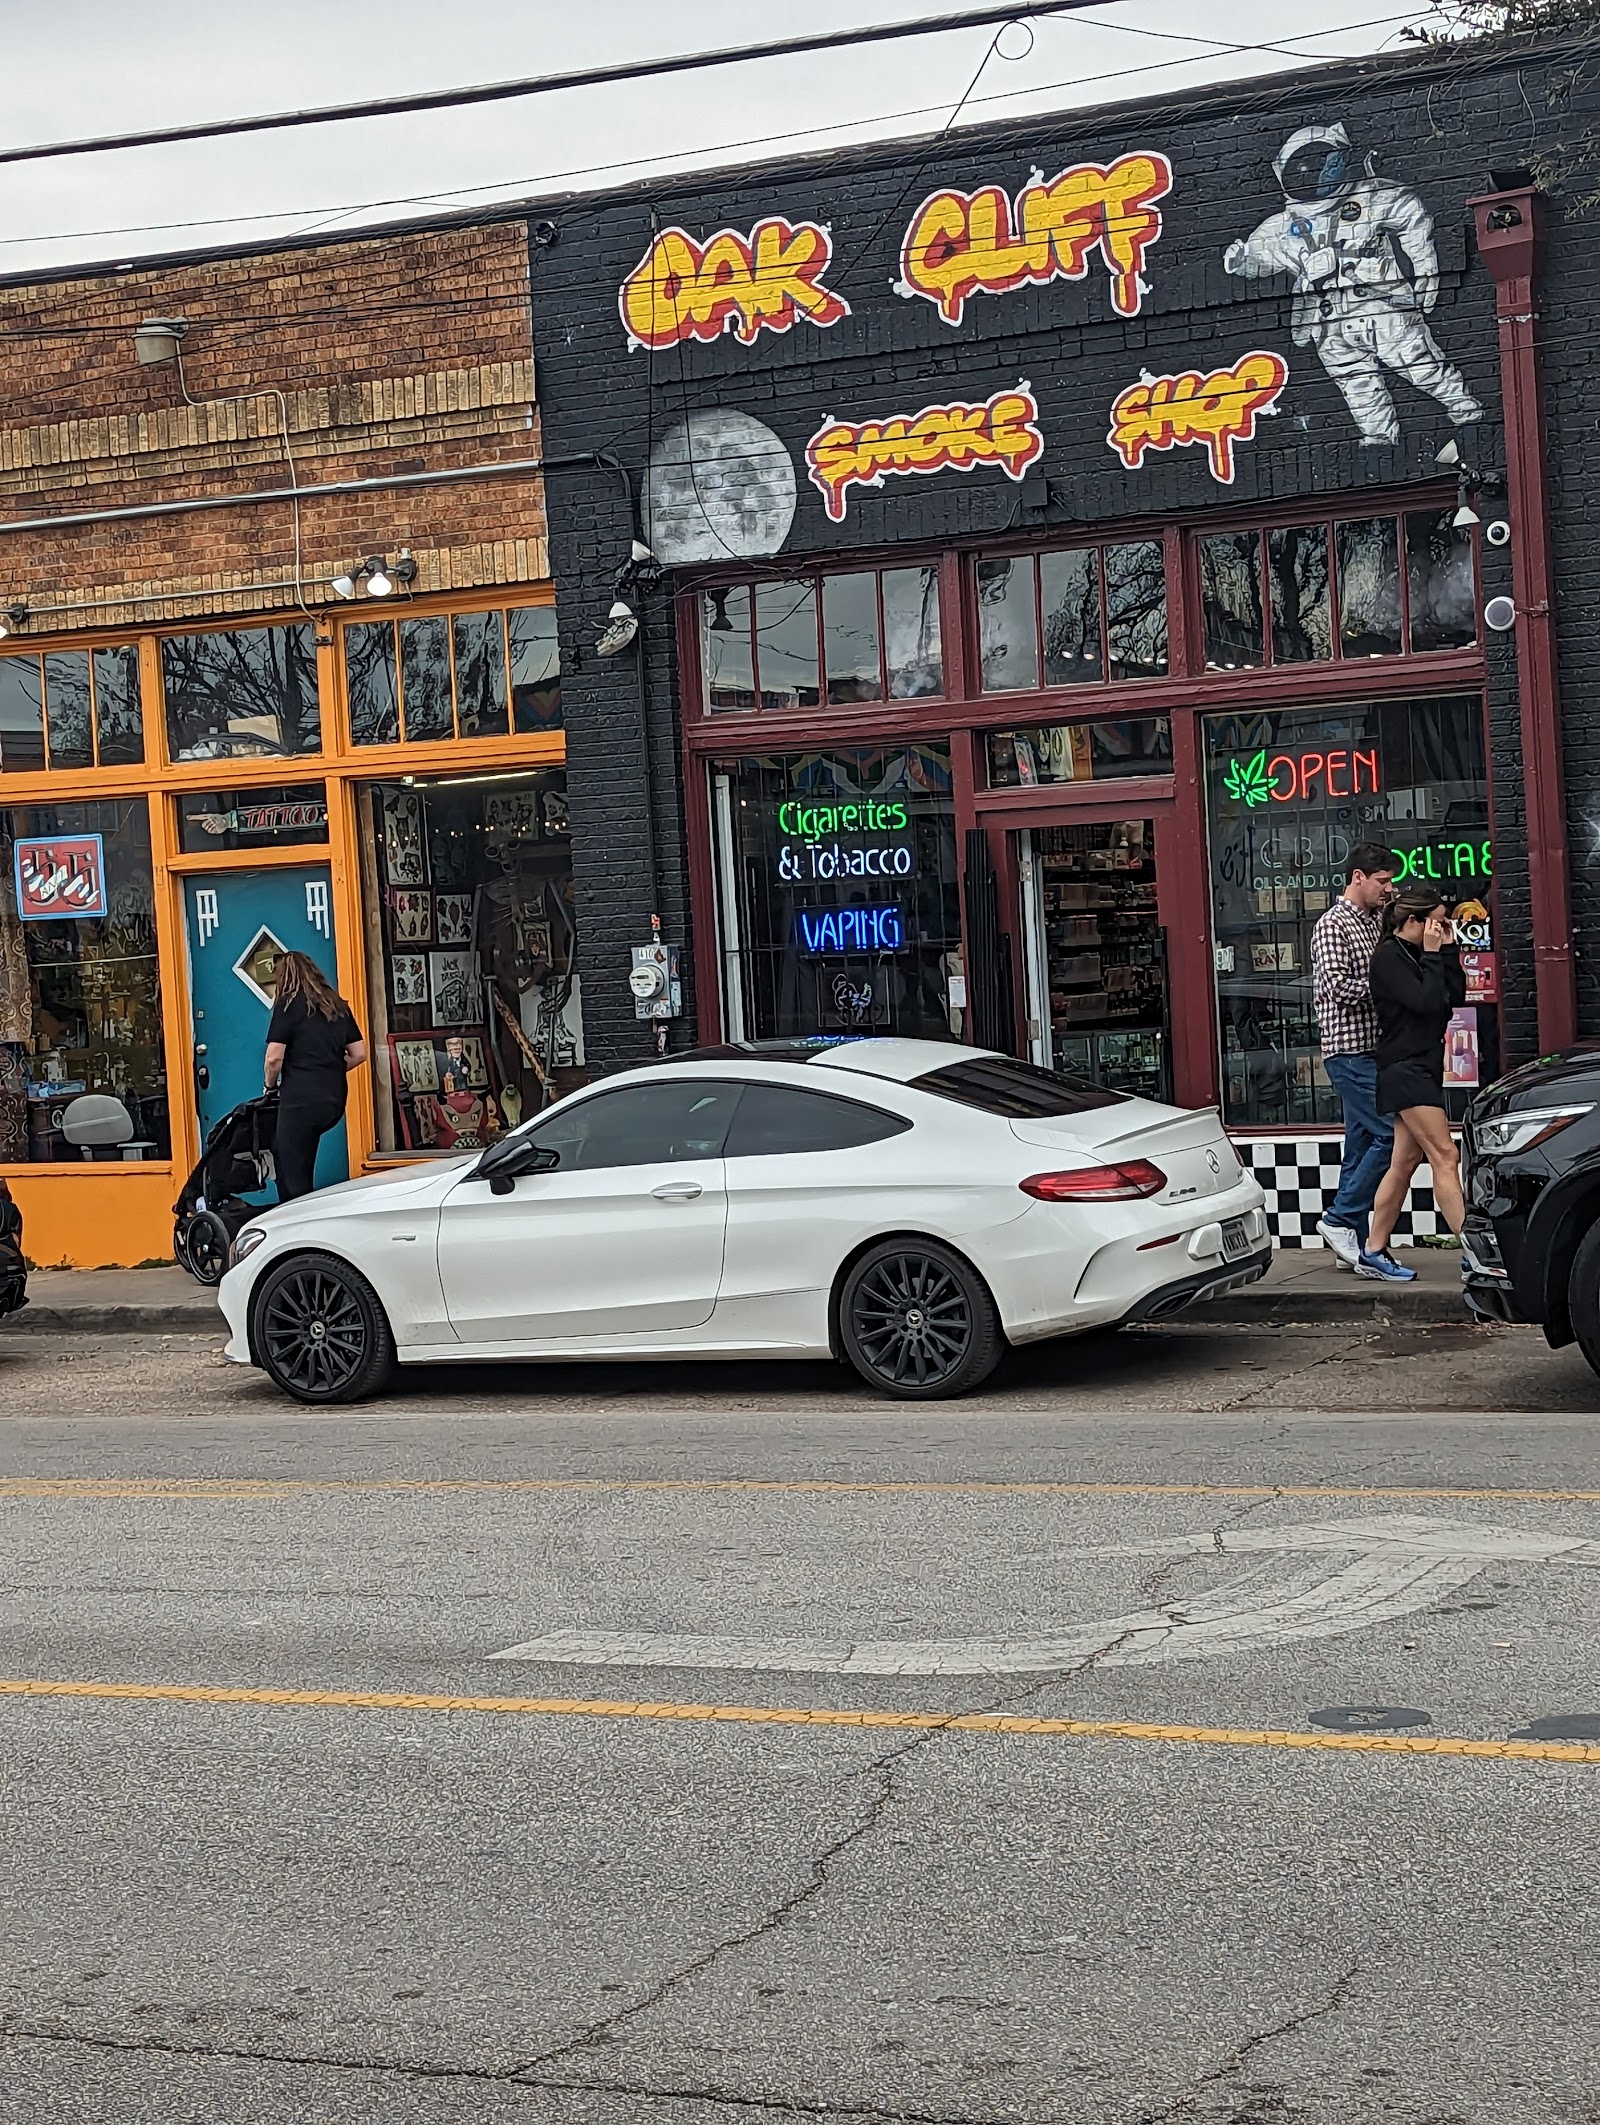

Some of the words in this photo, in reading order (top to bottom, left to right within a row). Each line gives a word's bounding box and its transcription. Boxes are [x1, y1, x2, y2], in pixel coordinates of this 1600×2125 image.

[619, 216, 852, 350] OAK
[901, 151, 1172, 326] CLIFF
[806, 390, 1043, 522] SMOKE
[1107, 350, 1288, 483] SHOP
[1267, 749, 1379, 802] OPEN
[245, 804, 318, 828] TATTOO
[779, 799, 908, 843] Cigarettes
[778, 845, 802, 880] &
[806, 844, 911, 879] Tobacco
[1260, 835, 1349, 868] CBD
[1391, 842, 1476, 882] DELTA
[802, 907, 901, 952] VAPING
[1451, 916, 1491, 945] Koi
